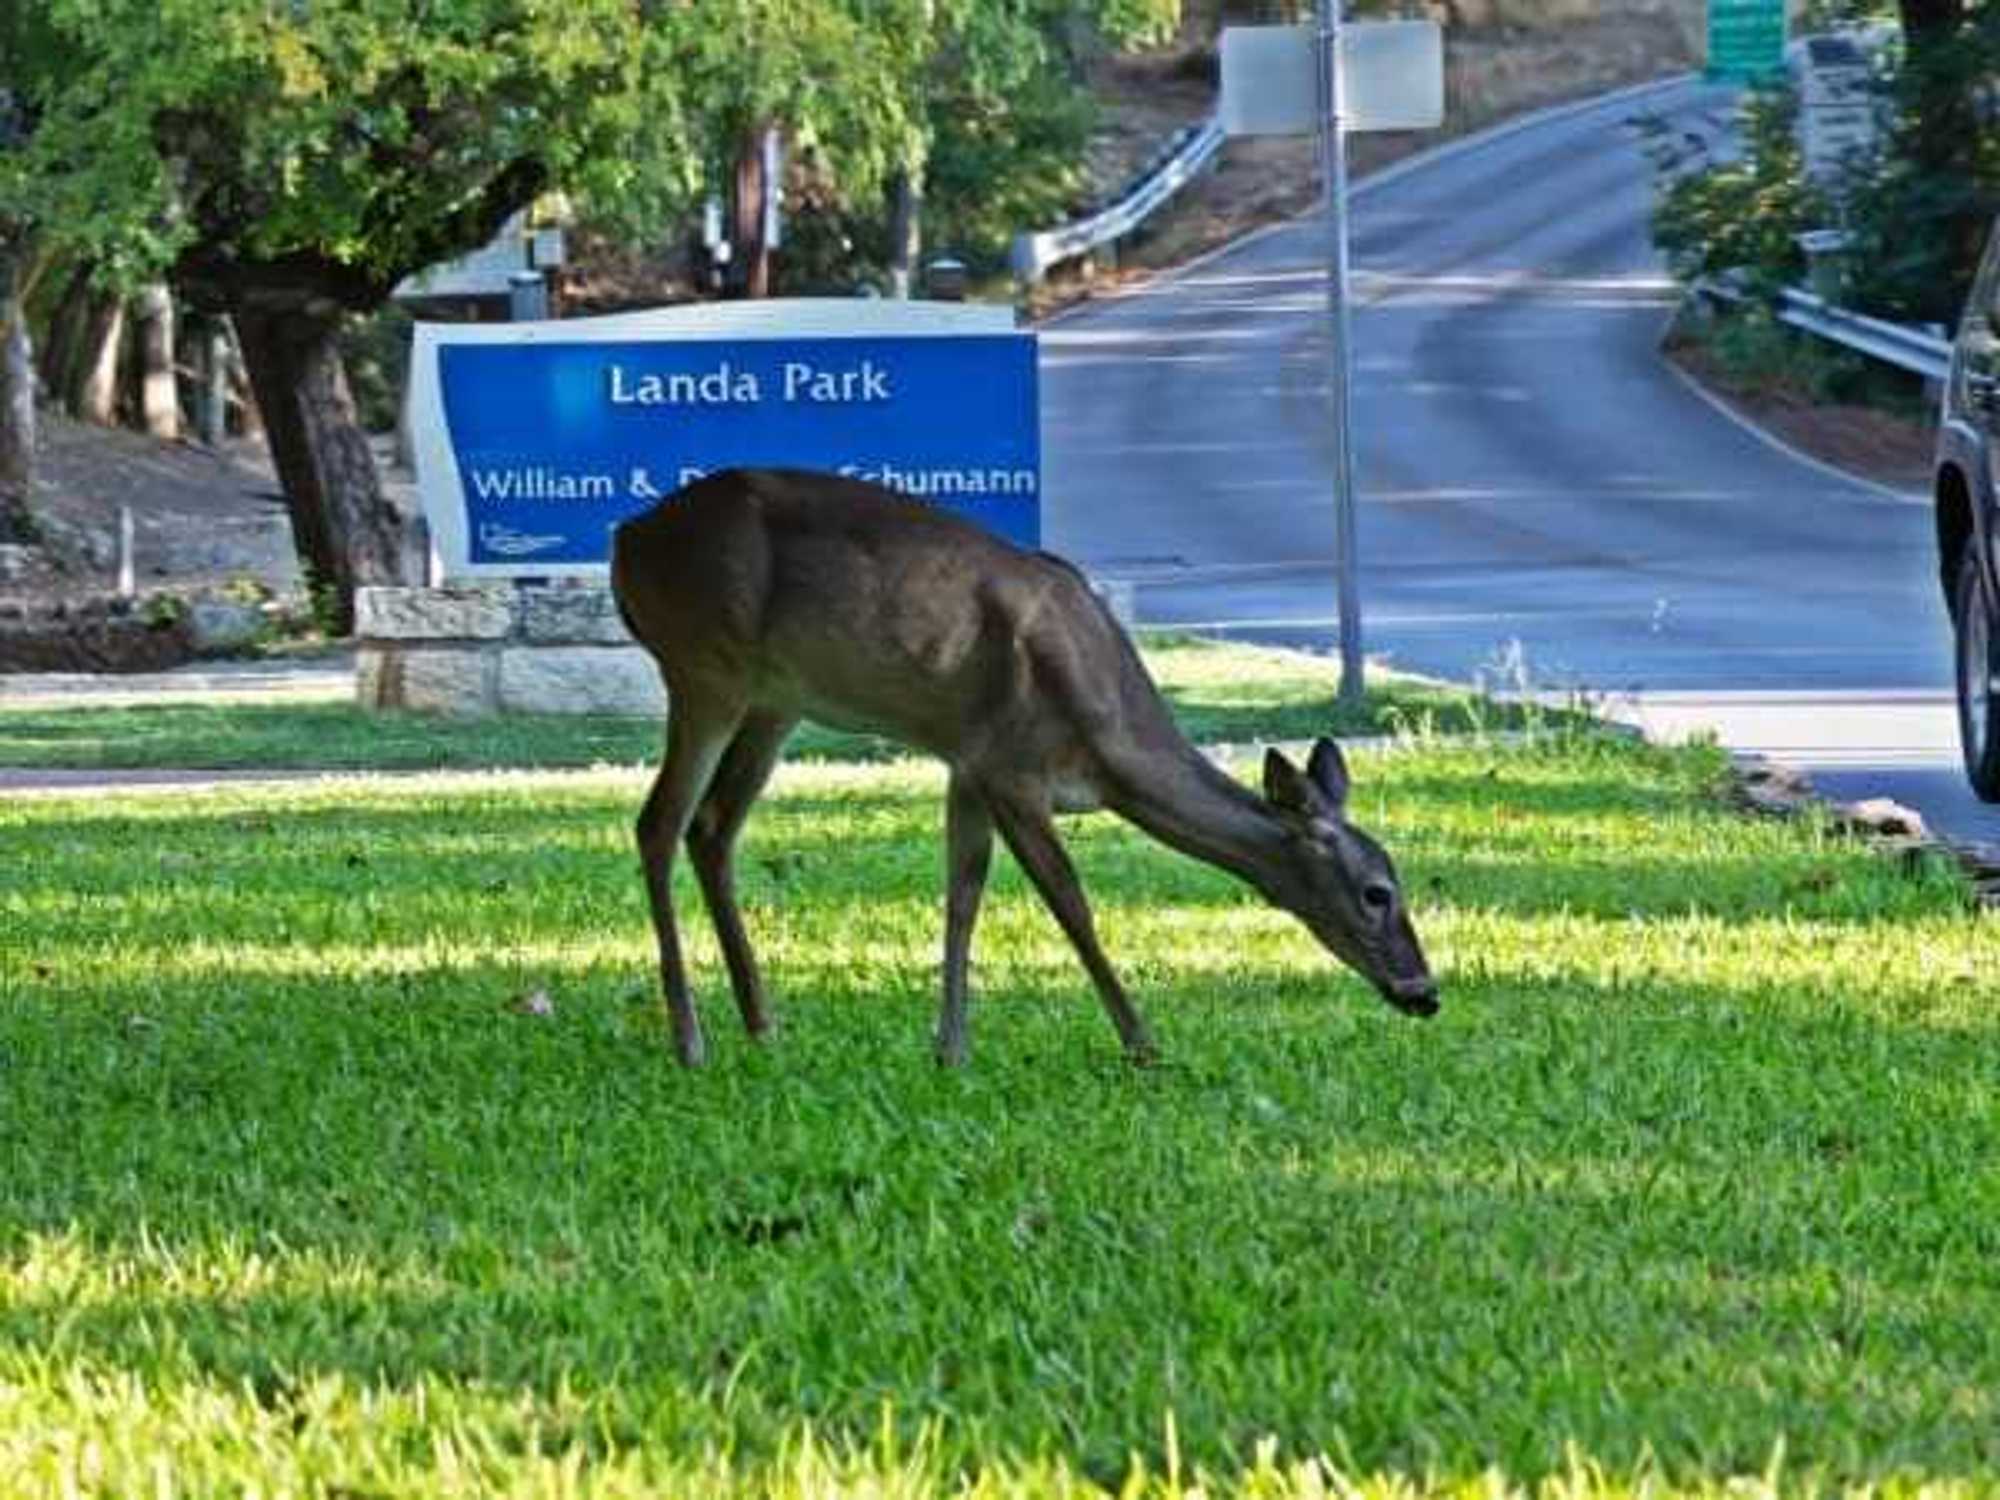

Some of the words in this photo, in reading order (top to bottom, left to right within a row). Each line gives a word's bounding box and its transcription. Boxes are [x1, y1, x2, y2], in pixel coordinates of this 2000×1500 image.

[610, 361, 759, 403] Landa
[784, 361, 890, 401] Park
[472, 467, 614, 500] William
[630, 467, 661, 499] &
